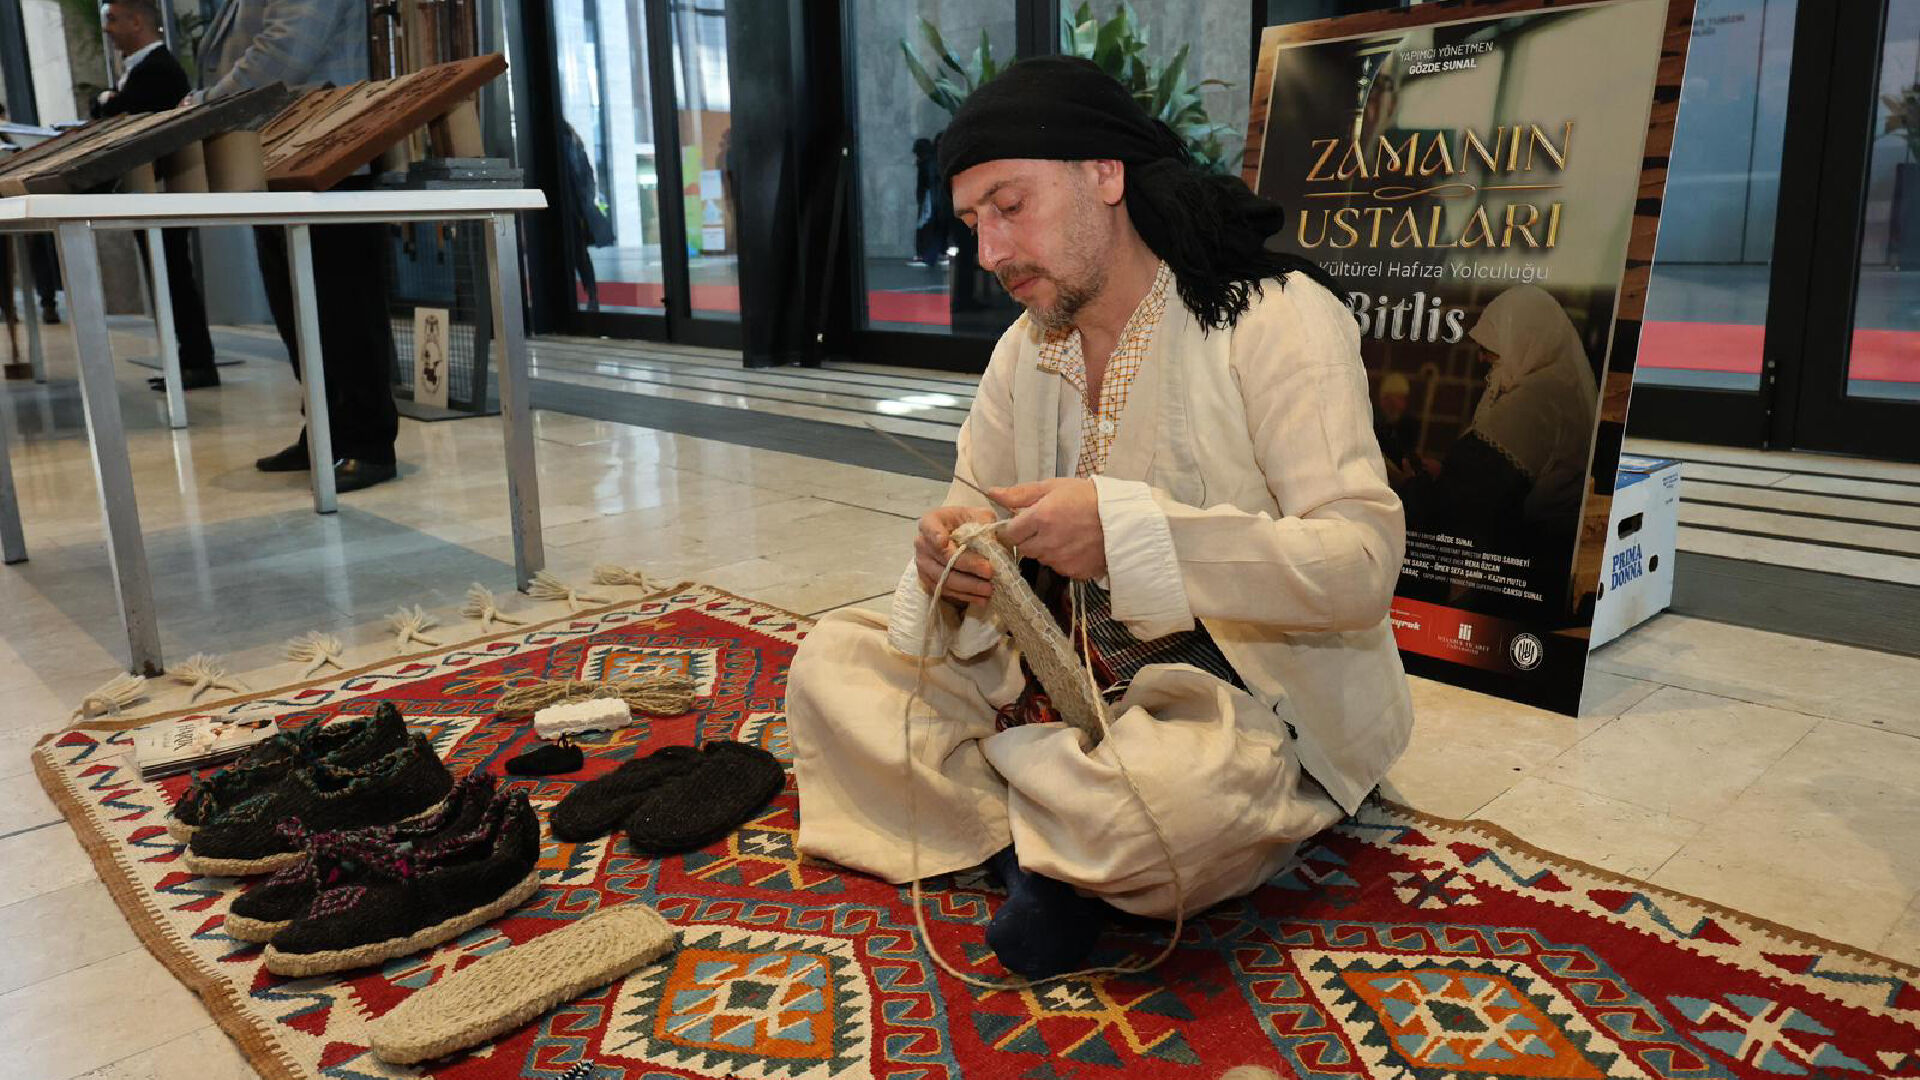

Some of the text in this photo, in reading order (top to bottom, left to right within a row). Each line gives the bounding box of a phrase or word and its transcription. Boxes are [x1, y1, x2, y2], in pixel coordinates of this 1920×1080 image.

[1439, 41, 1494, 58] YÖNETMEN
[1409, 57, 1476, 75] GÖZDE SUNAL
[1306, 121, 1575, 183] ZAMANIN
[1297, 203, 1562, 250] USTALARI
[1388, 260, 1443, 278] Hafıza
[1450, 262, 1549, 284] Yolculuğu
[1345, 291, 1465, 344] Bitlis
[1612, 543, 1643, 573] PRIMA
[1610, 561, 1643, 591] DONNA
